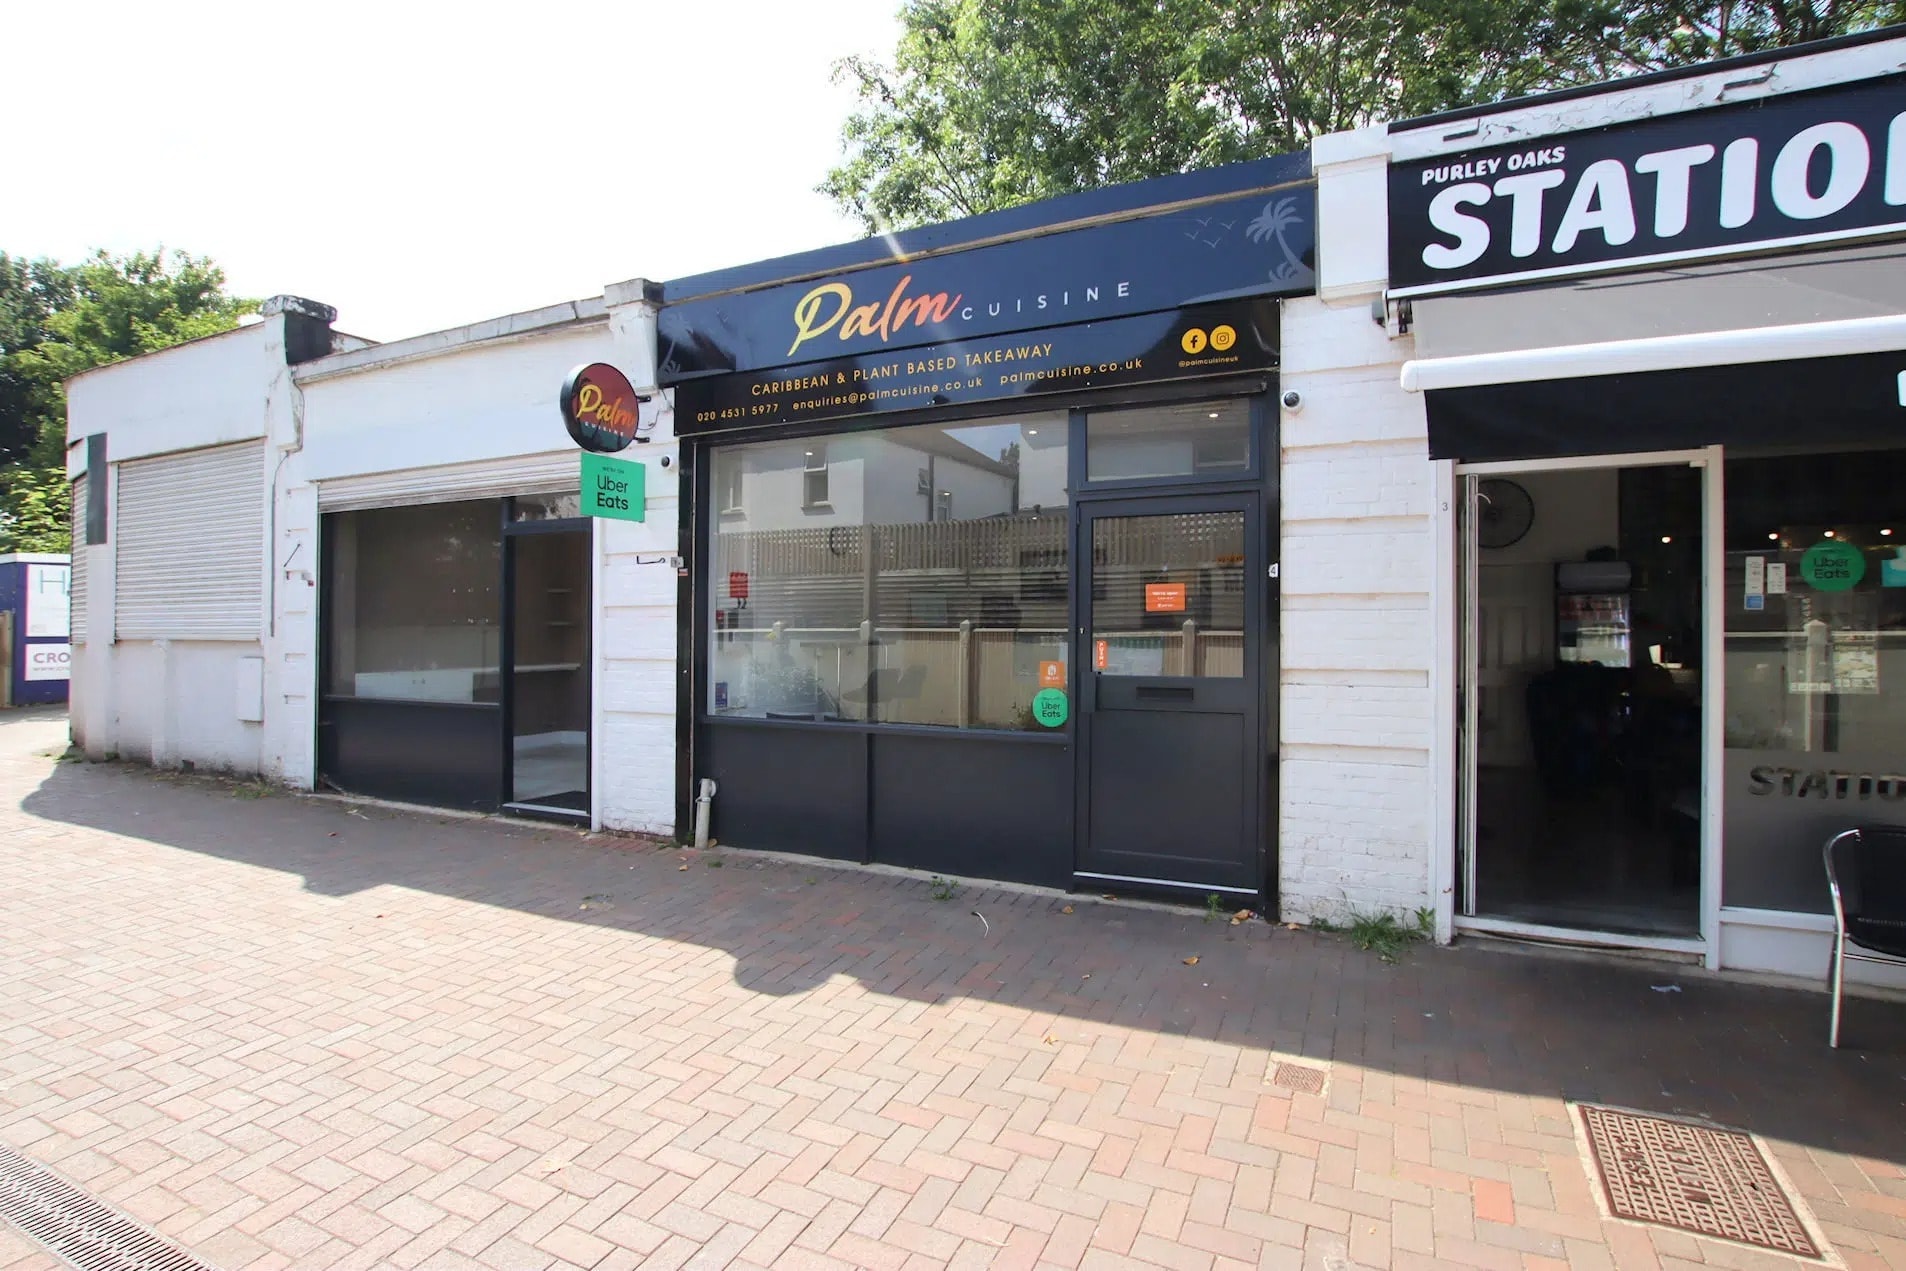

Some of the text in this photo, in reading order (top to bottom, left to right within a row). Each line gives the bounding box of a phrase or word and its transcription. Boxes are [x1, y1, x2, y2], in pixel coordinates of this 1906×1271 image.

[1422, 146, 1566, 186] PURLEY OAKS
[1422, 110, 1906, 270] STATIO
[787, 275, 1131, 356] Palm CUISINE
[751, 343, 1053, 397] CARIBBEAN & PLANT BASED TAKEAWAY
[1178, 356, 1239, 368] @palmcuisineuk
[697, 357, 1143, 422] 020 4531 5977 enquiries@palmcuisine.co.uk palmcuisine.co.uk
[576, 384, 635, 428] Palm
[597, 474, 629, 494] Uber
[596, 492, 629, 511] Eats
[1441, 502, 1449, 512] 3
[1270, 566, 1276, 576] 4
[1813, 557, 1849, 568] Uber
[1814, 568, 1850, 579] Eats
[1041, 702, 1061, 710] Uber
[1041, 710, 1061, 718] Eats
